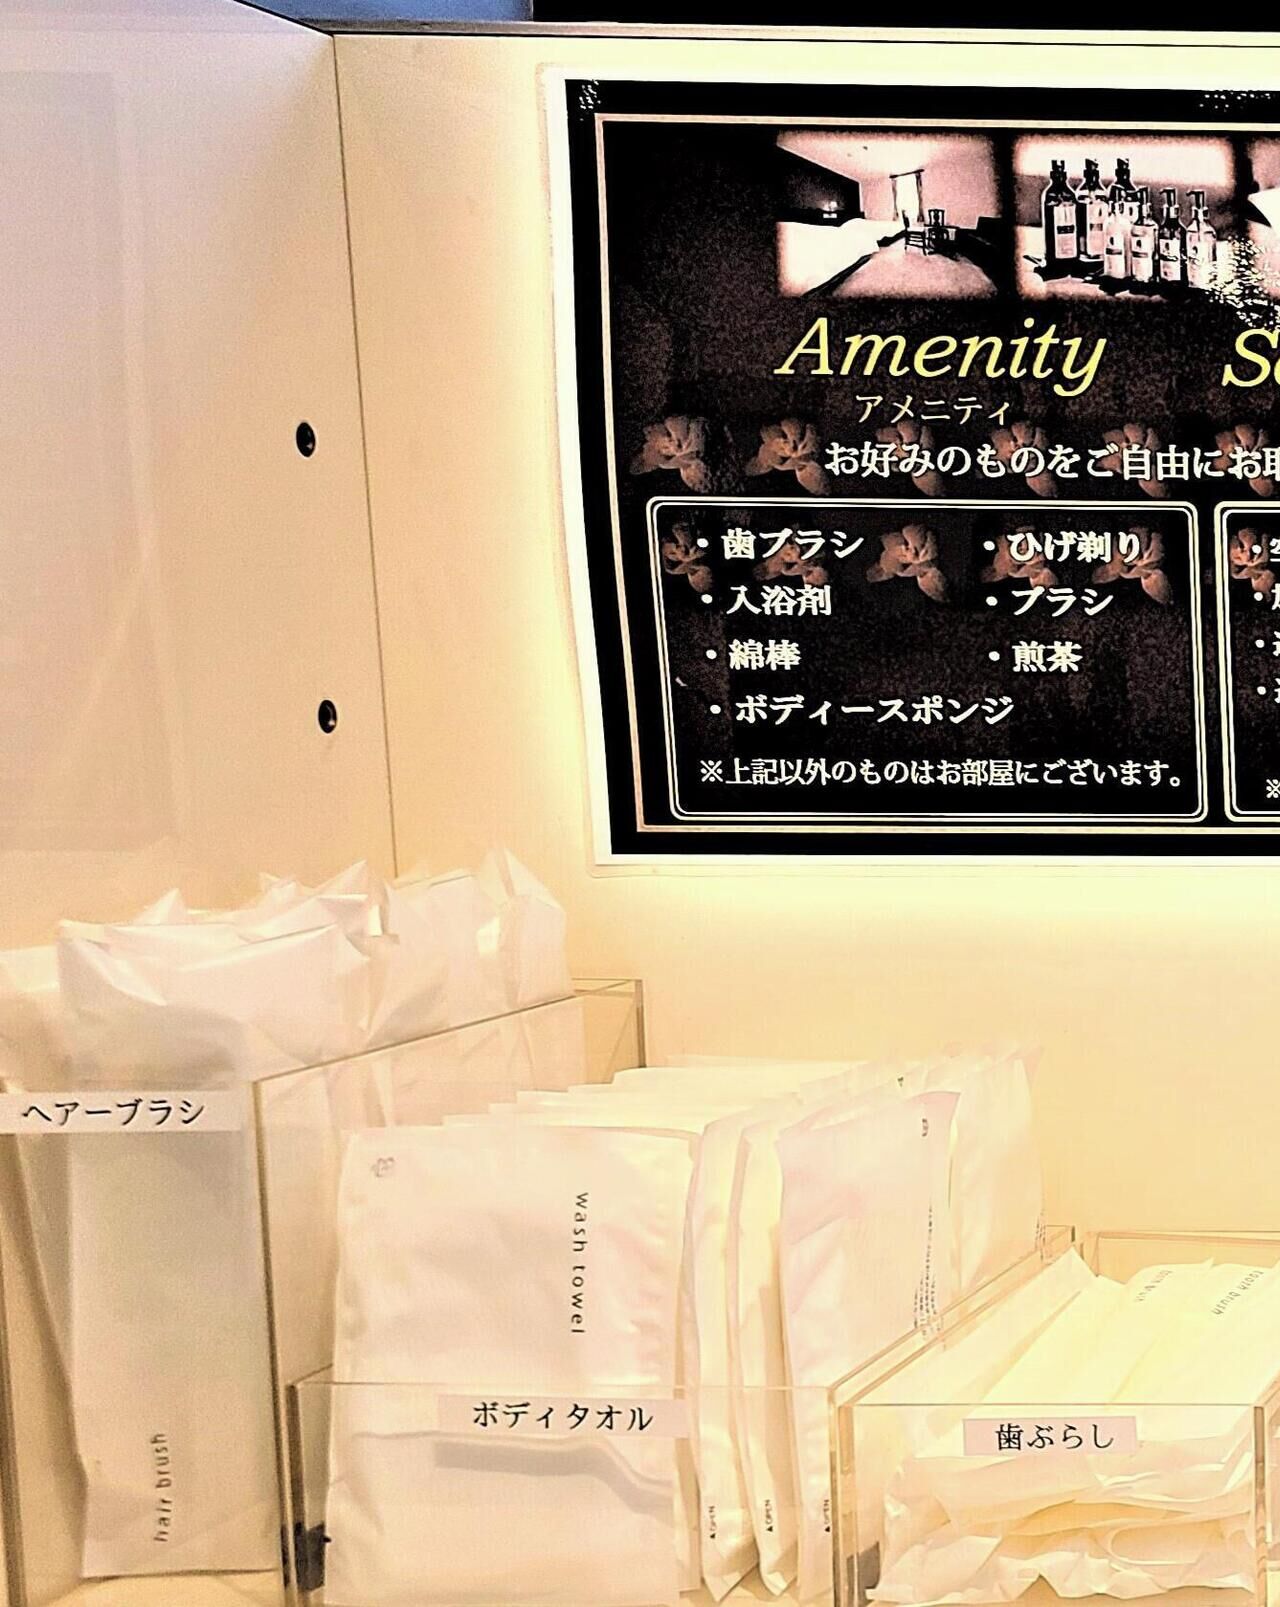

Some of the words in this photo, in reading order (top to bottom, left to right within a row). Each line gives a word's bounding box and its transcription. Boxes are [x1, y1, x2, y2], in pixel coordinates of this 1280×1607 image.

[774, 317, 1107, 397] Amenity
[855, 395, 1010, 426] アメニティ
[721, 529, 865, 560] 歯ブラシ
[1006, 531, 1142, 562] ひげ剃り
[726, 585, 832, 616] 入浴剤
[1012, 587, 1114, 617] ブラシ
[729, 639, 801, 670] 綿棒
[1012, 641, 1083, 672] 煎茶
[735, 695, 1013, 725] ボディースポンジ
[700, 758, 1181, 789] ※上記以外のものはお部屋にございます。
[21, 1098, 206, 1127] ヘアーブラシ
[570, 1192, 590, 1253] wash
[569, 1265, 589, 1335] towel
[473, 1401, 654, 1432] ボディタオル
[994, 1423, 1114, 1451] 歯ぶらし
[150, 1431, 172, 1489] brush
[153, 1497, 173, 1544] hair
